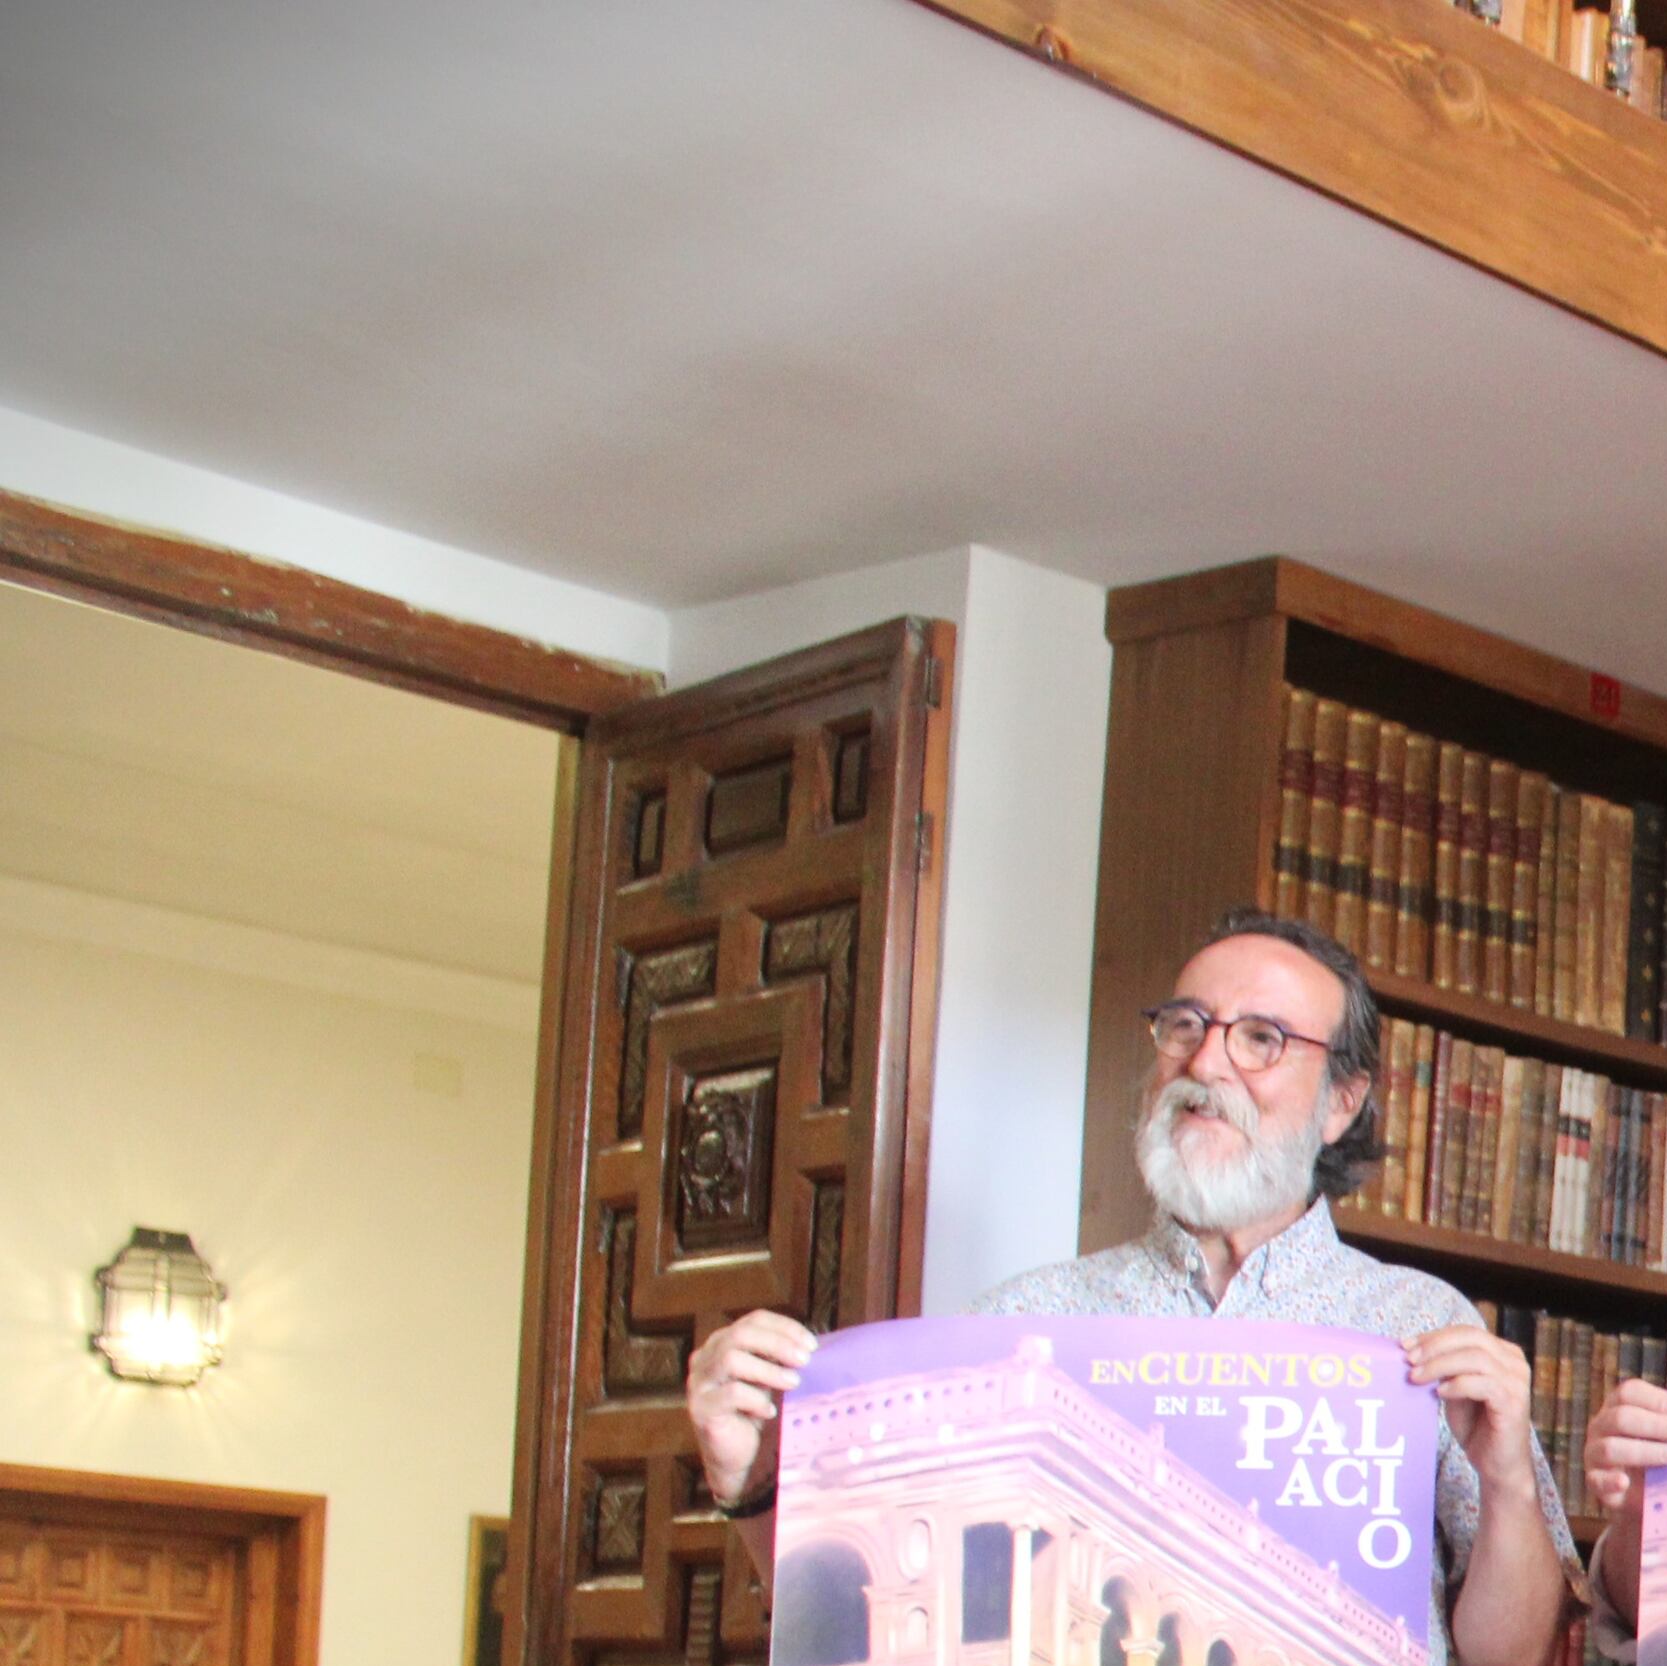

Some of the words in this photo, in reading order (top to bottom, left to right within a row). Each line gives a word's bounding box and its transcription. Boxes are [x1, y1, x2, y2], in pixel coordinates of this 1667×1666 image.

[1154, 1396, 1187, 1416] EN
[1196, 1397, 1226, 1416] EL
[1235, 1396, 1405, 1470] PAL
[1275, 1457, 1403, 1515] ACI
[1357, 1518, 1412, 1569] O
